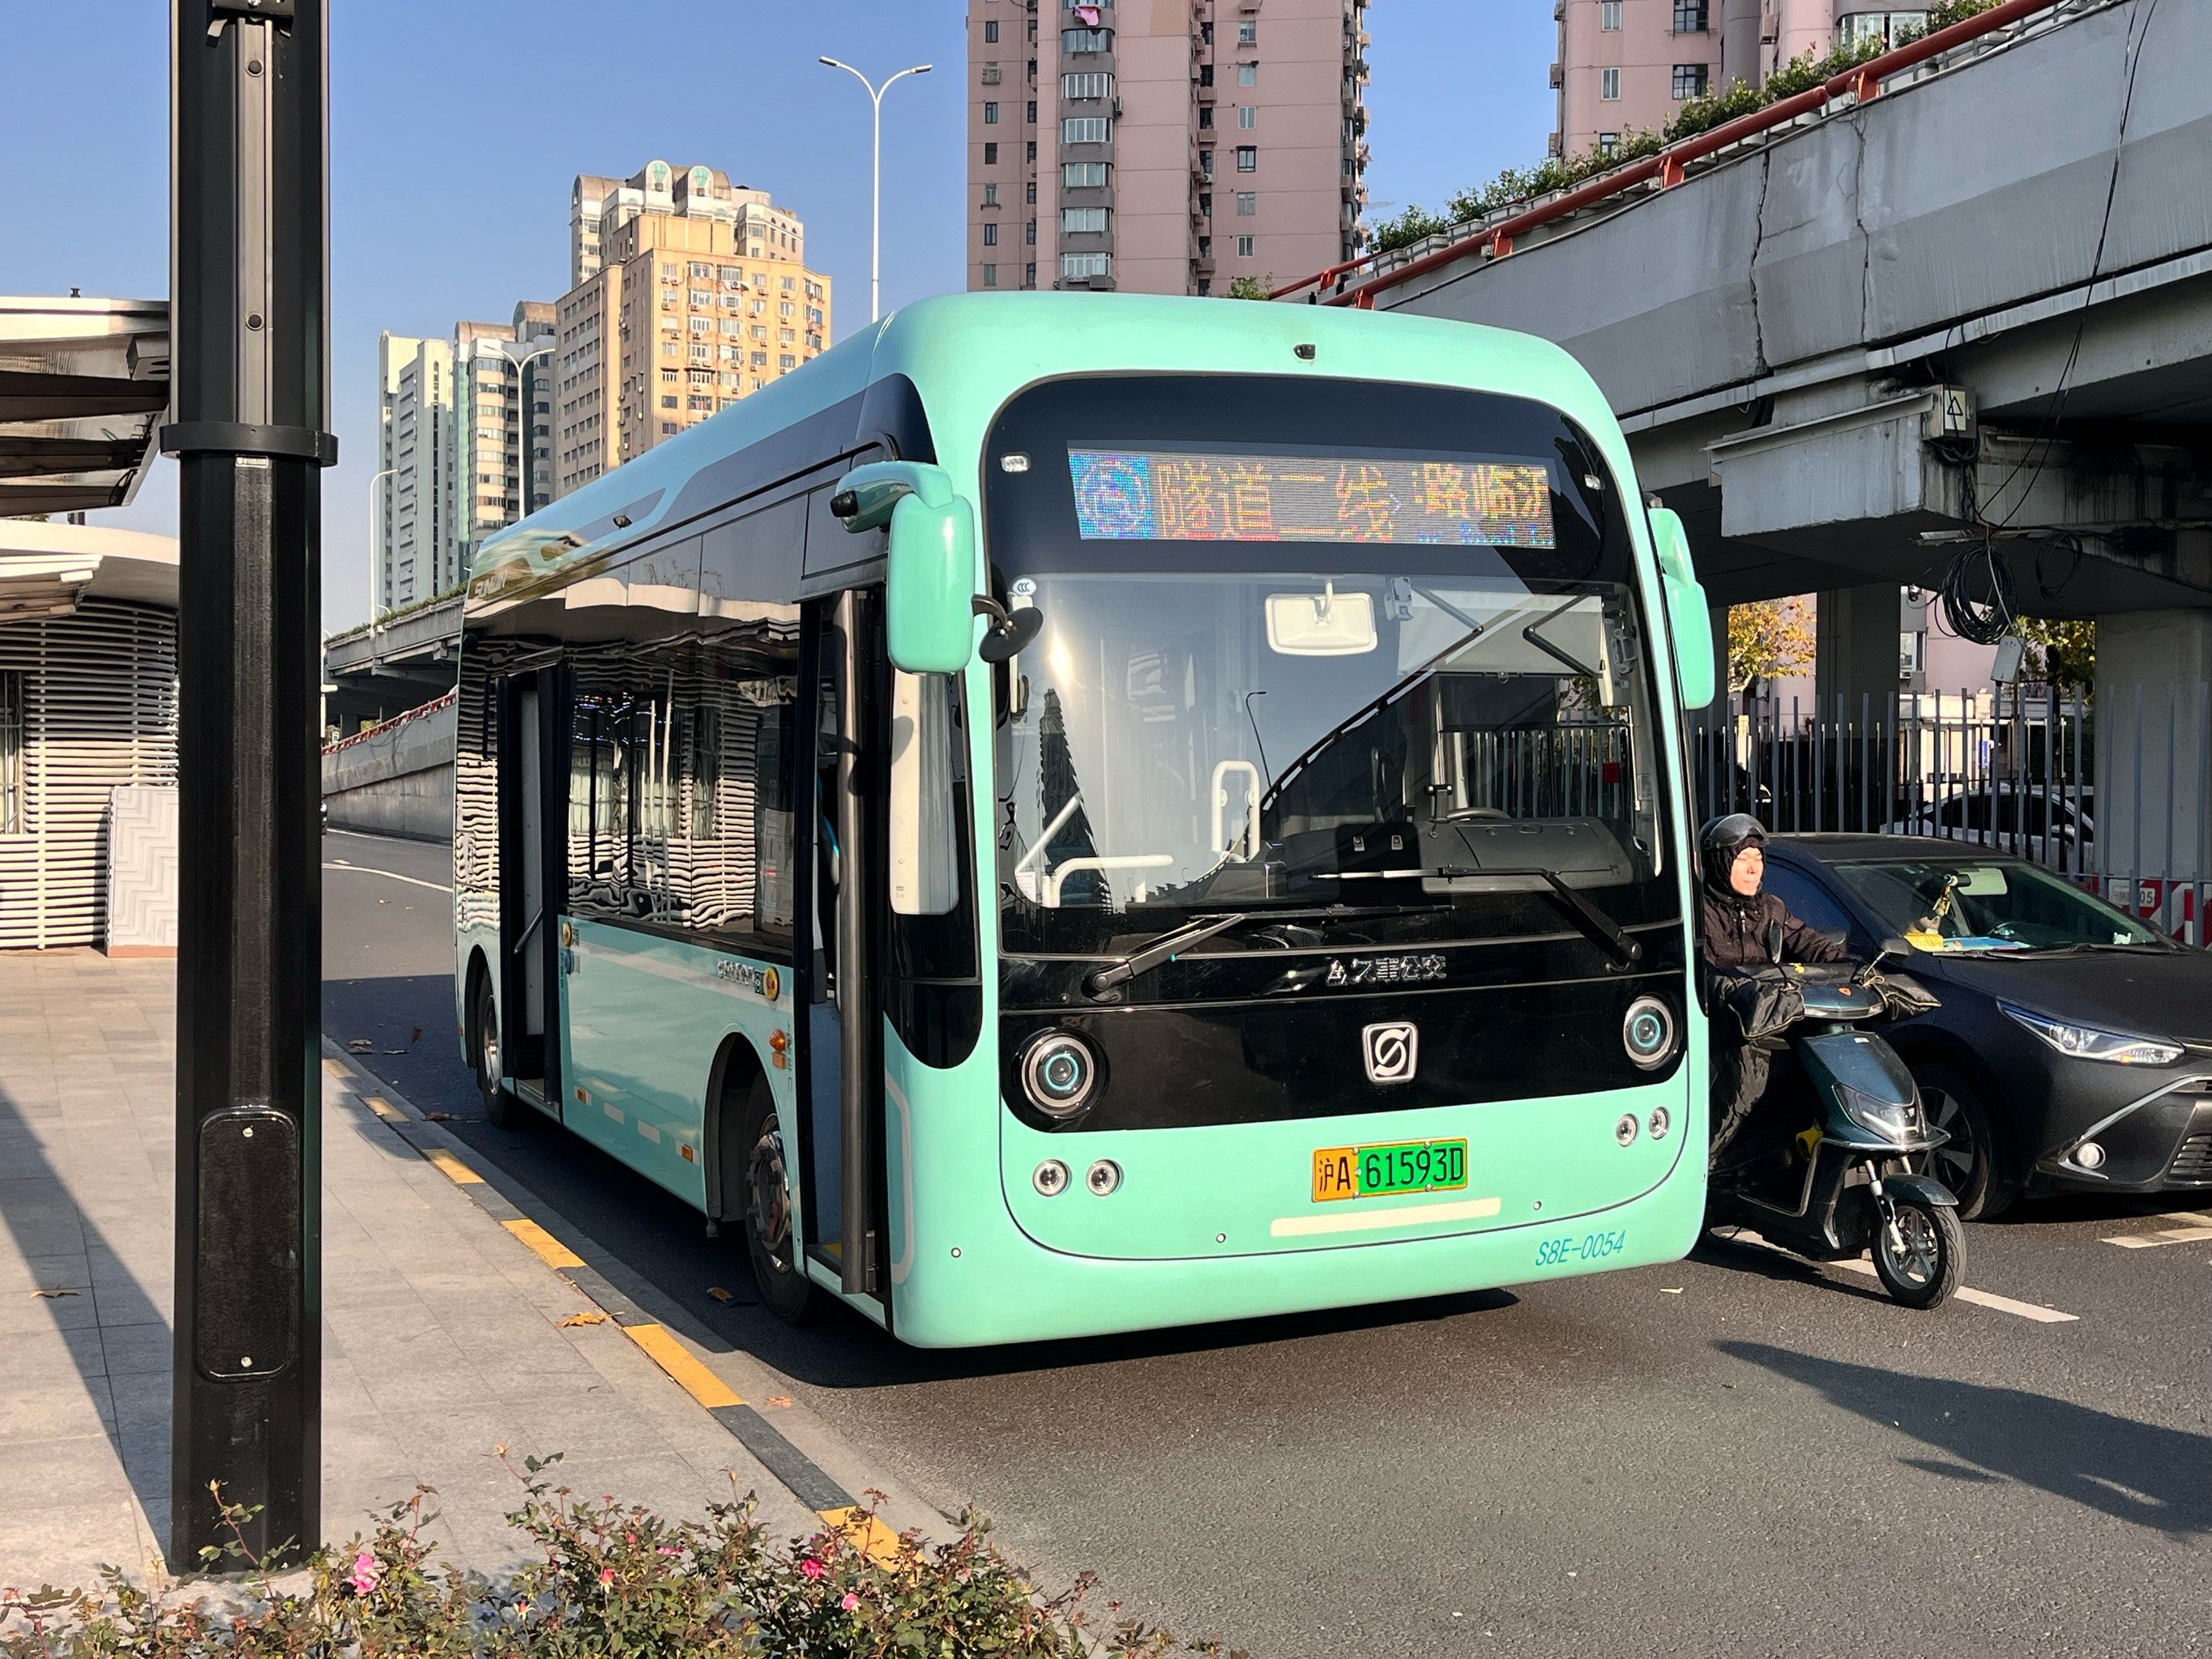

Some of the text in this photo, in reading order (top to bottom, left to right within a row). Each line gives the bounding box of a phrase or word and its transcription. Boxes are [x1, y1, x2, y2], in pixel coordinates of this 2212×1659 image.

[1157, 460, 1394, 541] 隧道二线
[1319, 1146, 1465, 1192] 沪A 61593D
[1535, 1230, 1625, 1266] S8E-0054
